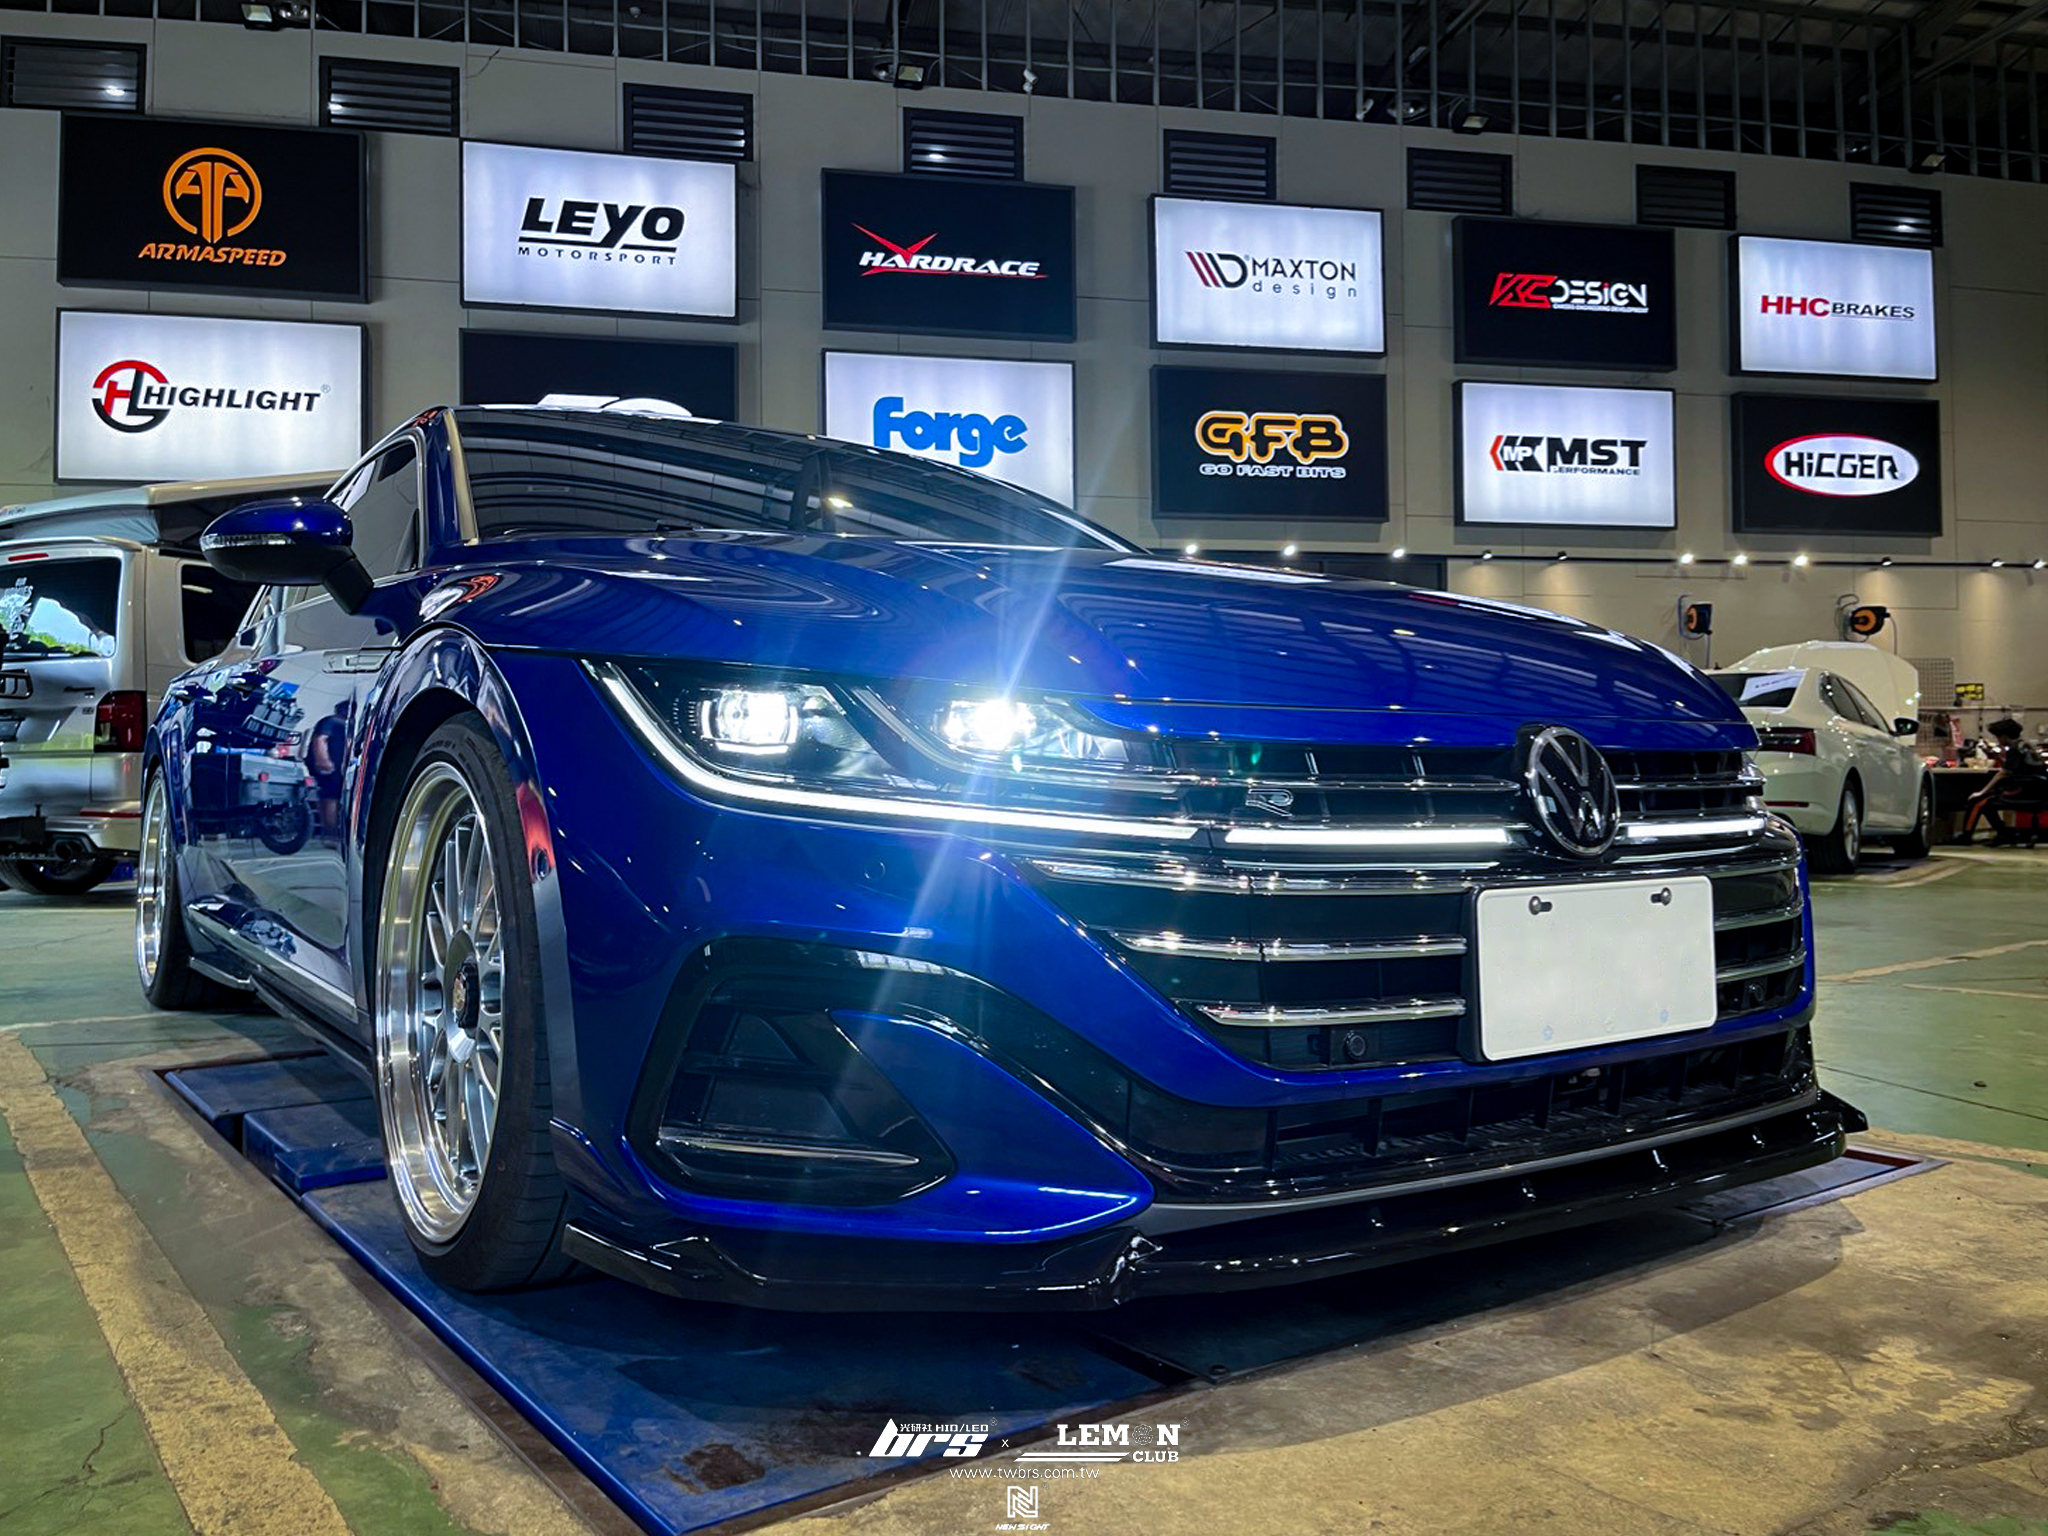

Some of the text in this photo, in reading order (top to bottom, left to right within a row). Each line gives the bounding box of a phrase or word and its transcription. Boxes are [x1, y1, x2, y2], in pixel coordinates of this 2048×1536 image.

[138, 243, 287, 267] ARMASPEED
[518, 247, 676, 265] MOTORSPORT
[859, 251, 1041, 277] HARDRACE
[1252, 258, 1356, 281] MAXTON
[1252, 281, 1357, 300] design
[143, 385, 321, 412] HIGHLIGHT
[1195, 410, 1350, 465] GFB
[1547, 437, 1648, 472] MST
[1200, 463, 1347, 479] GO FAST BITS
